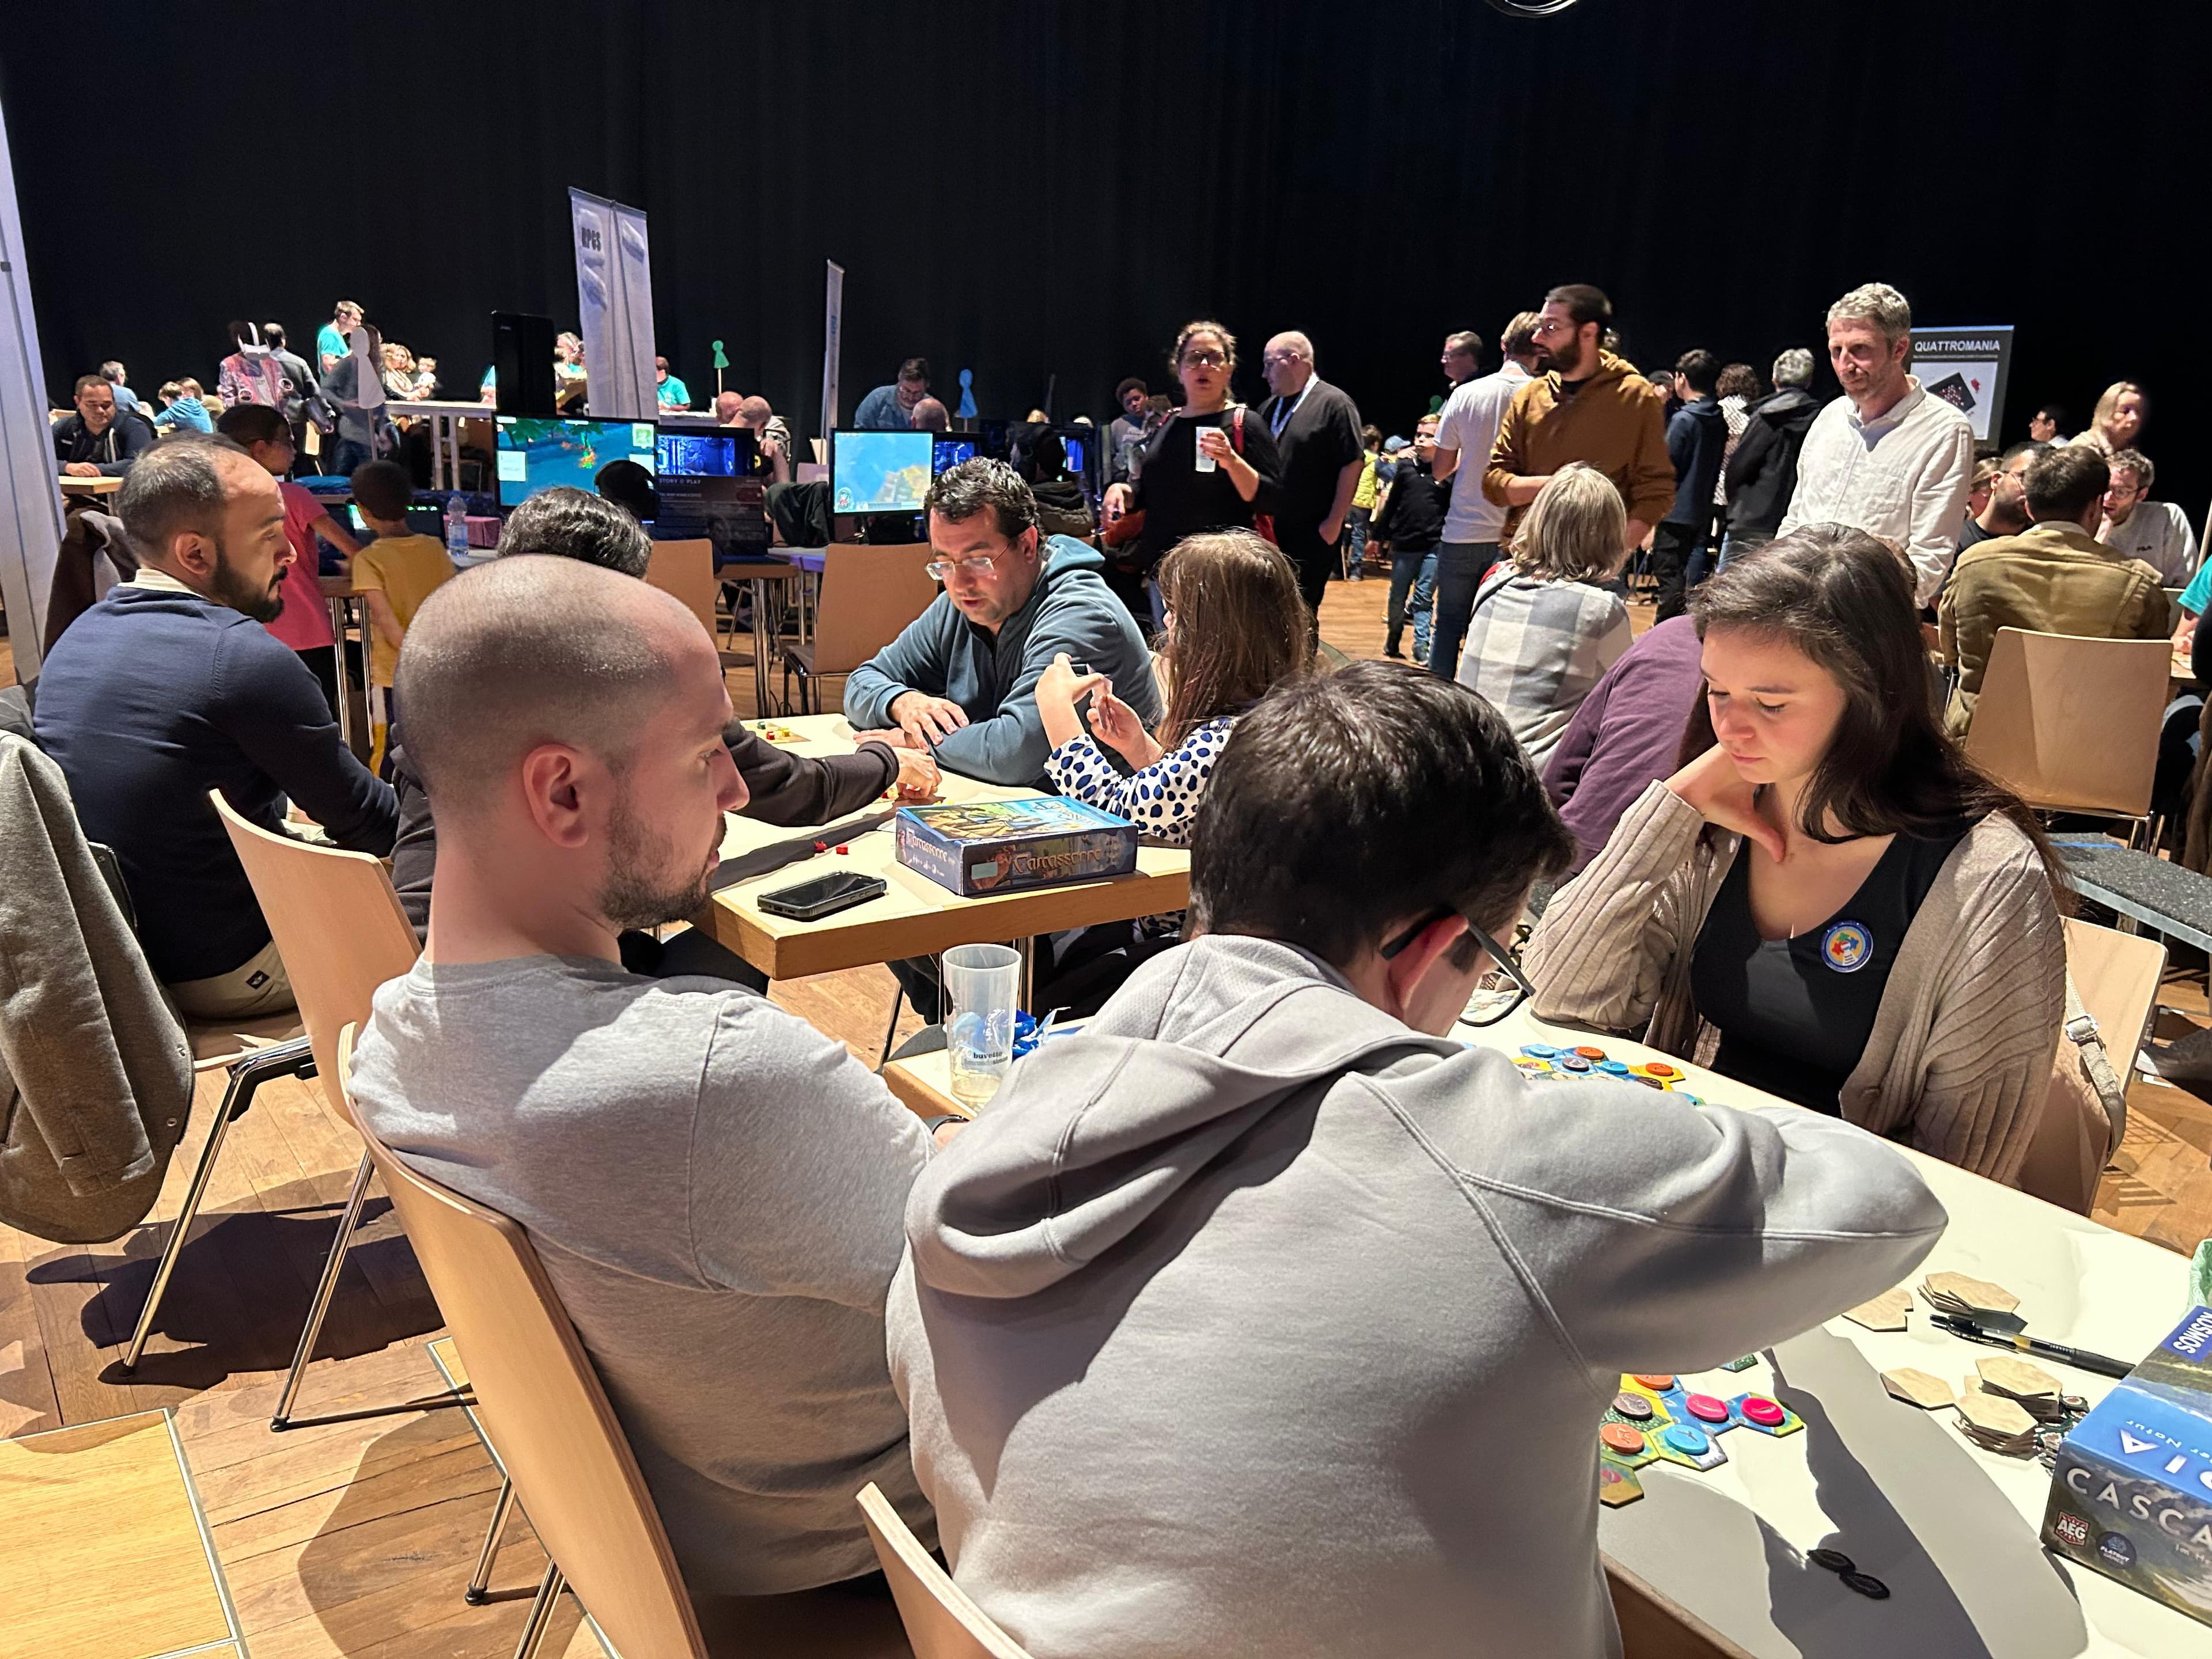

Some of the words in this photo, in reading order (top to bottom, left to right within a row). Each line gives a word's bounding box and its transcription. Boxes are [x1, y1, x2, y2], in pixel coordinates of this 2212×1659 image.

[1914, 339, 2001, 352] QUATTROMANIA
[2126, 1419, 2182, 1448] Natur
[2190, 1448, 2212, 1464] er
[2057, 1519, 2086, 1540] AEG
